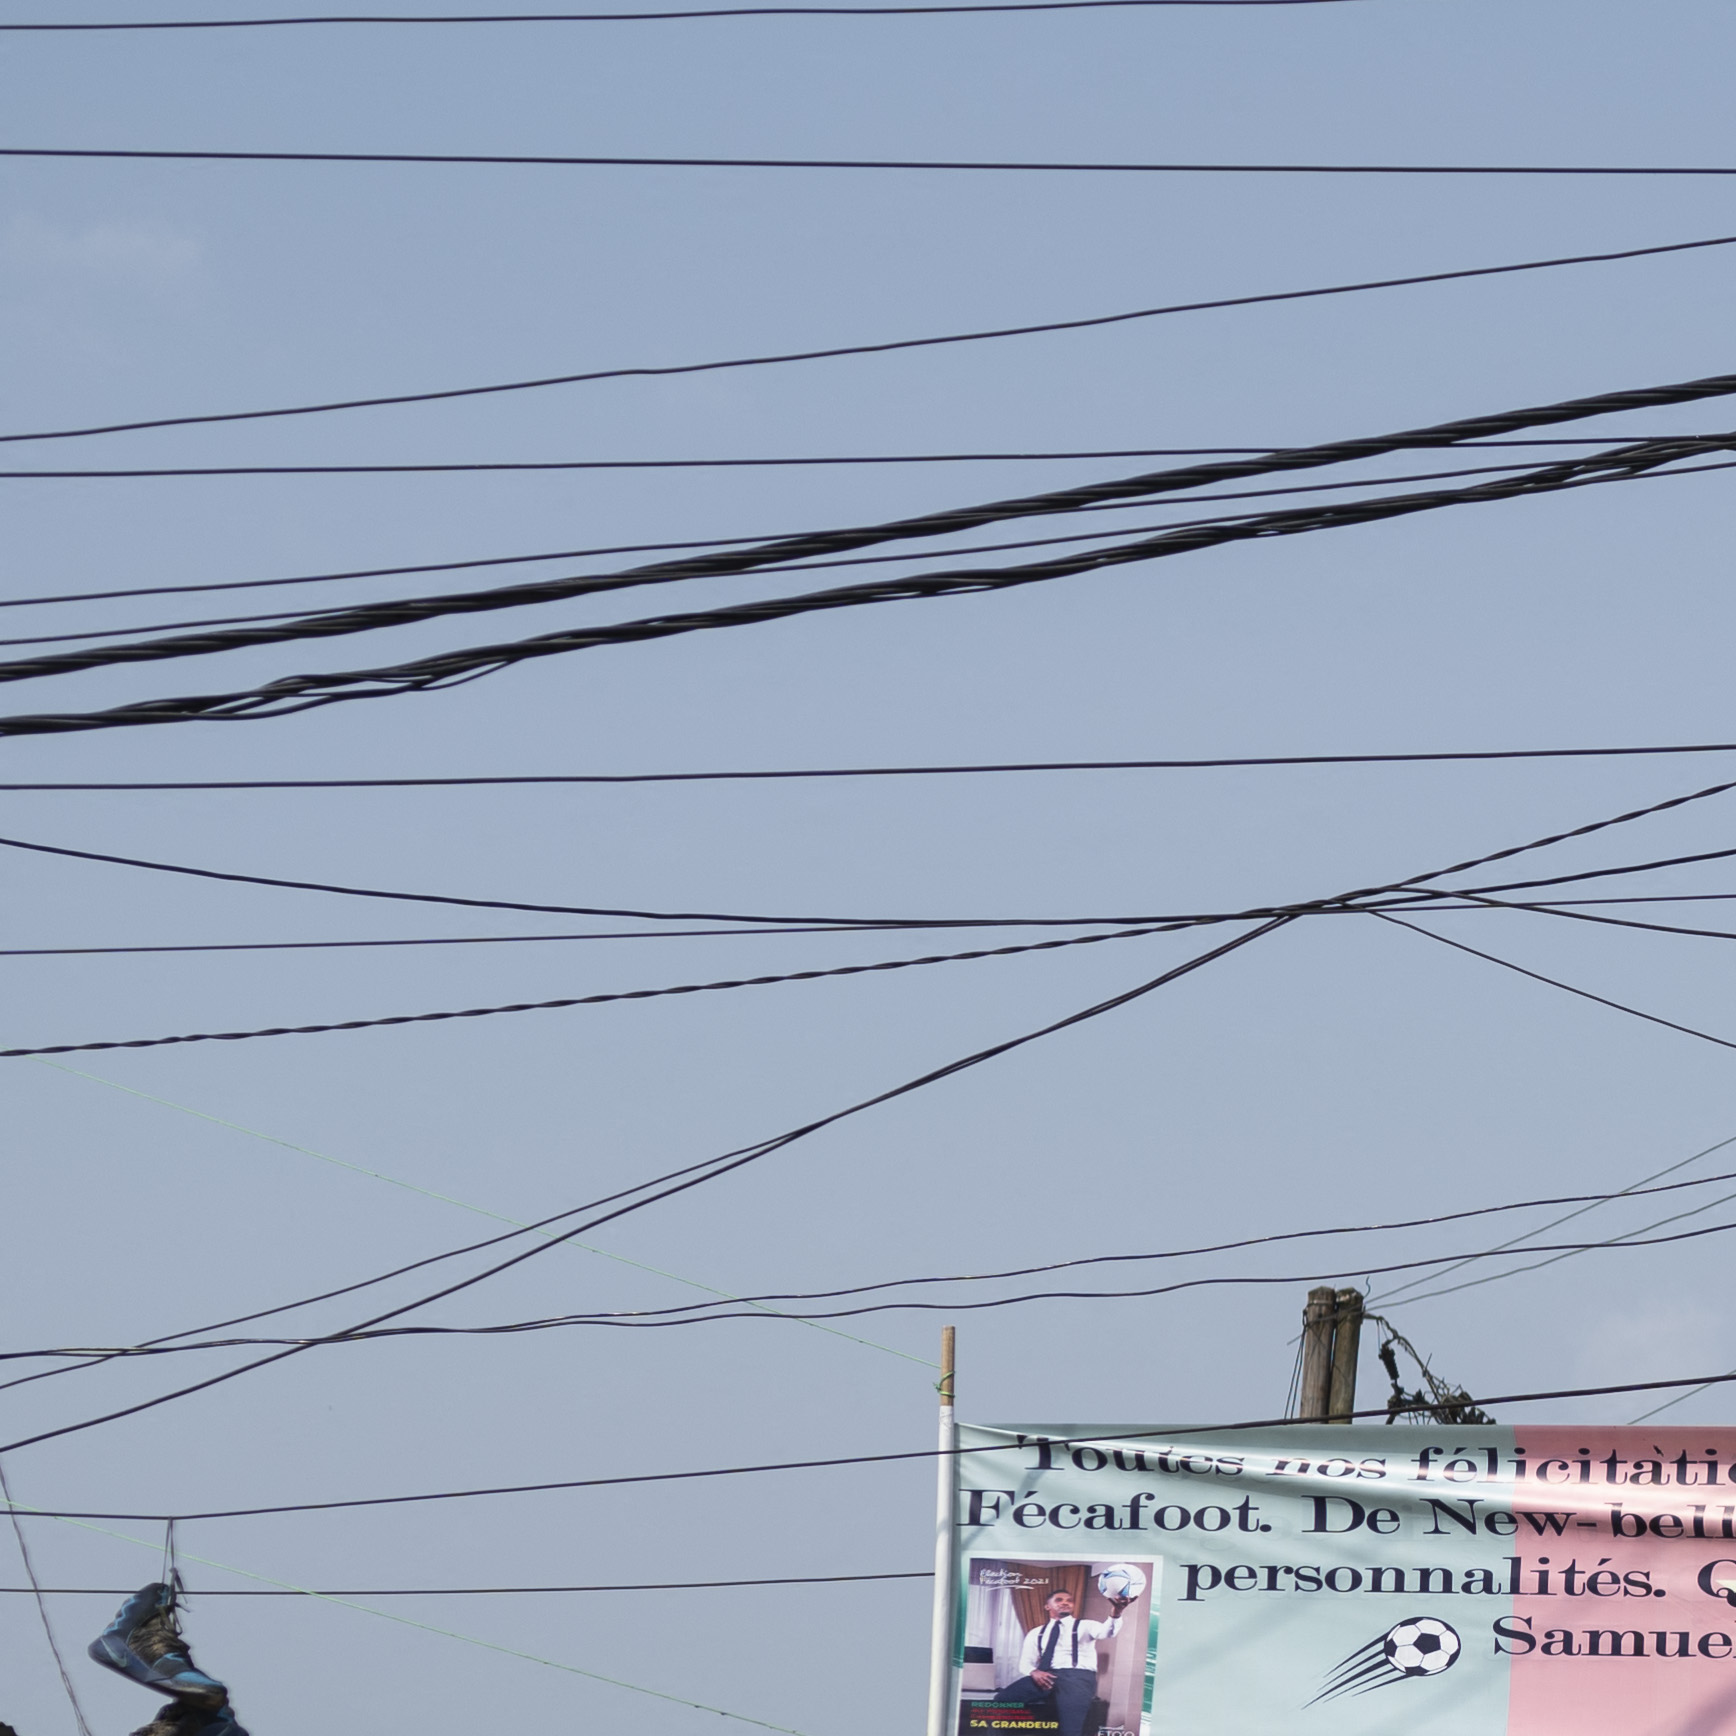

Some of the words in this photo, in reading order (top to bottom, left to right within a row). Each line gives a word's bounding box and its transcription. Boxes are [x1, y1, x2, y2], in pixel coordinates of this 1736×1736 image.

[1017, 1434, 1245, 1477] Toutes
[1266, 1456, 1387, 1479] nos
[955, 1488, 1272, 1532] Fécafoot.
[1301, 1495, 1400, 1535] De
[1178, 1555, 1666, 1602] personnalités.
[970, 1720, 988, 1728] SA
[991, 1720, 1059, 1728] GRANDEUR
